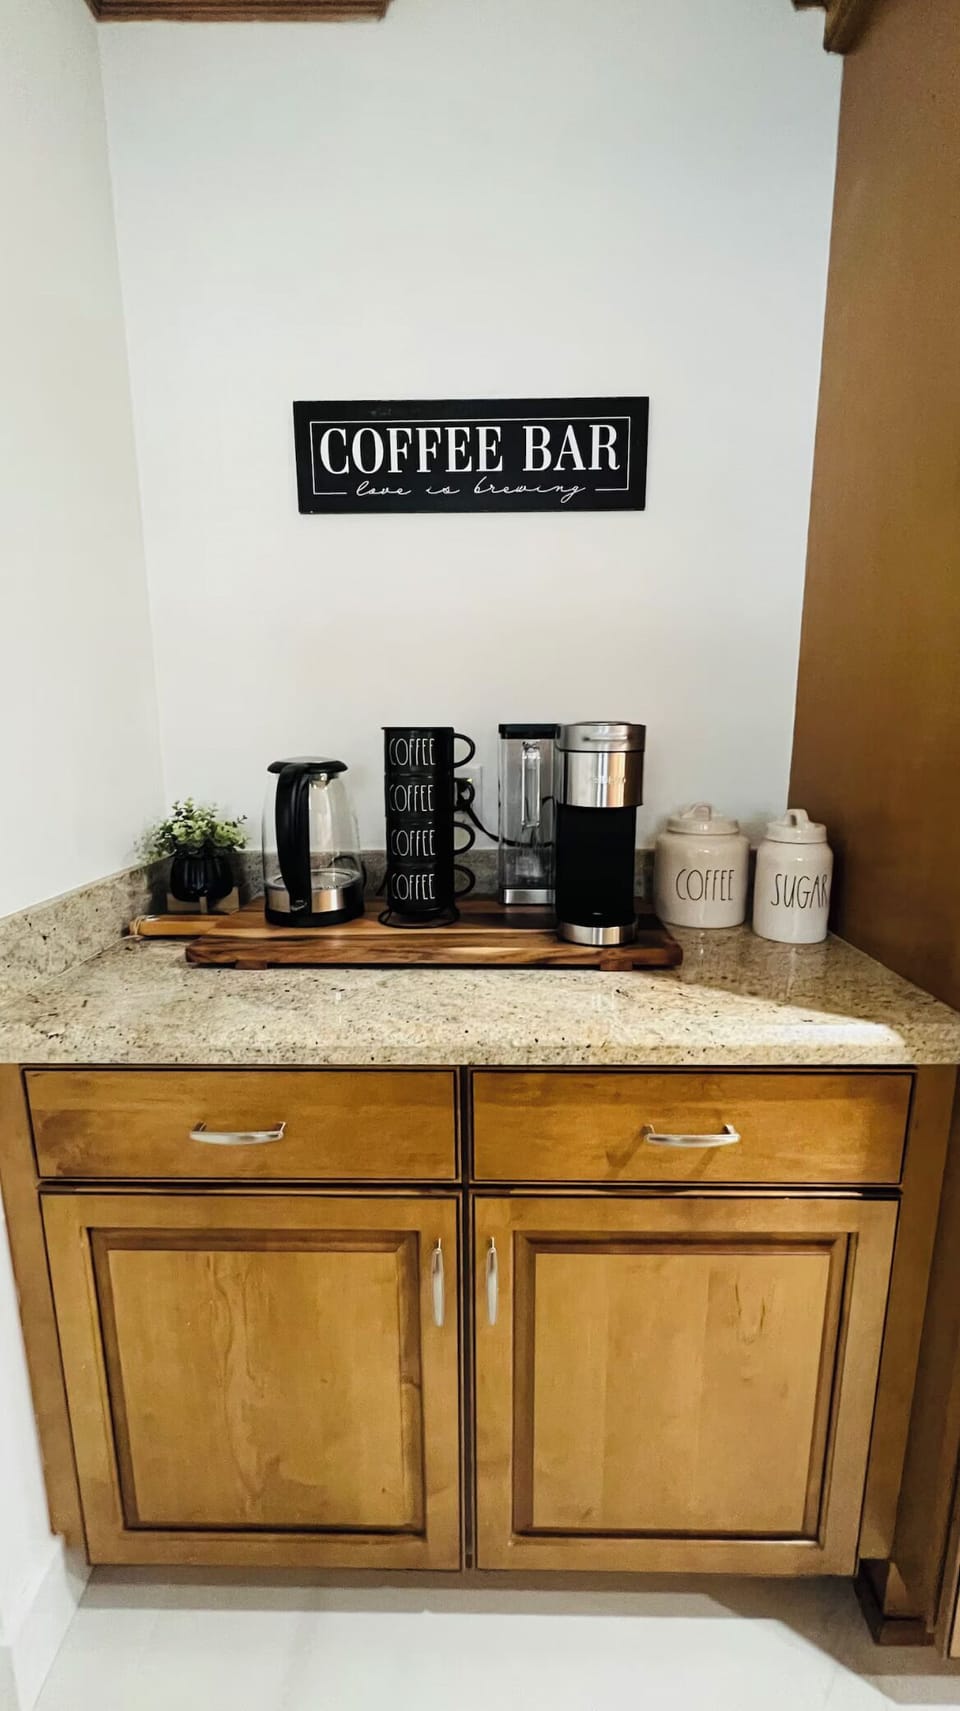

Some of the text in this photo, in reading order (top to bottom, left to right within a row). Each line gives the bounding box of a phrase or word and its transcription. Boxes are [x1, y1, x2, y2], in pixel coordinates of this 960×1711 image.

[320, 424, 621, 474] COFFEE BAR
[356, 476, 586, 503] love is brewing
[388, 738, 436, 766] COFFEE
[389, 784, 436, 812] COFFEE
[391, 829, 436, 856] COFFEE
[391, 873, 436, 900] COFFEE
[675, 868, 735, 901] COFFEE
[770, 873, 828, 909] SUGAR
